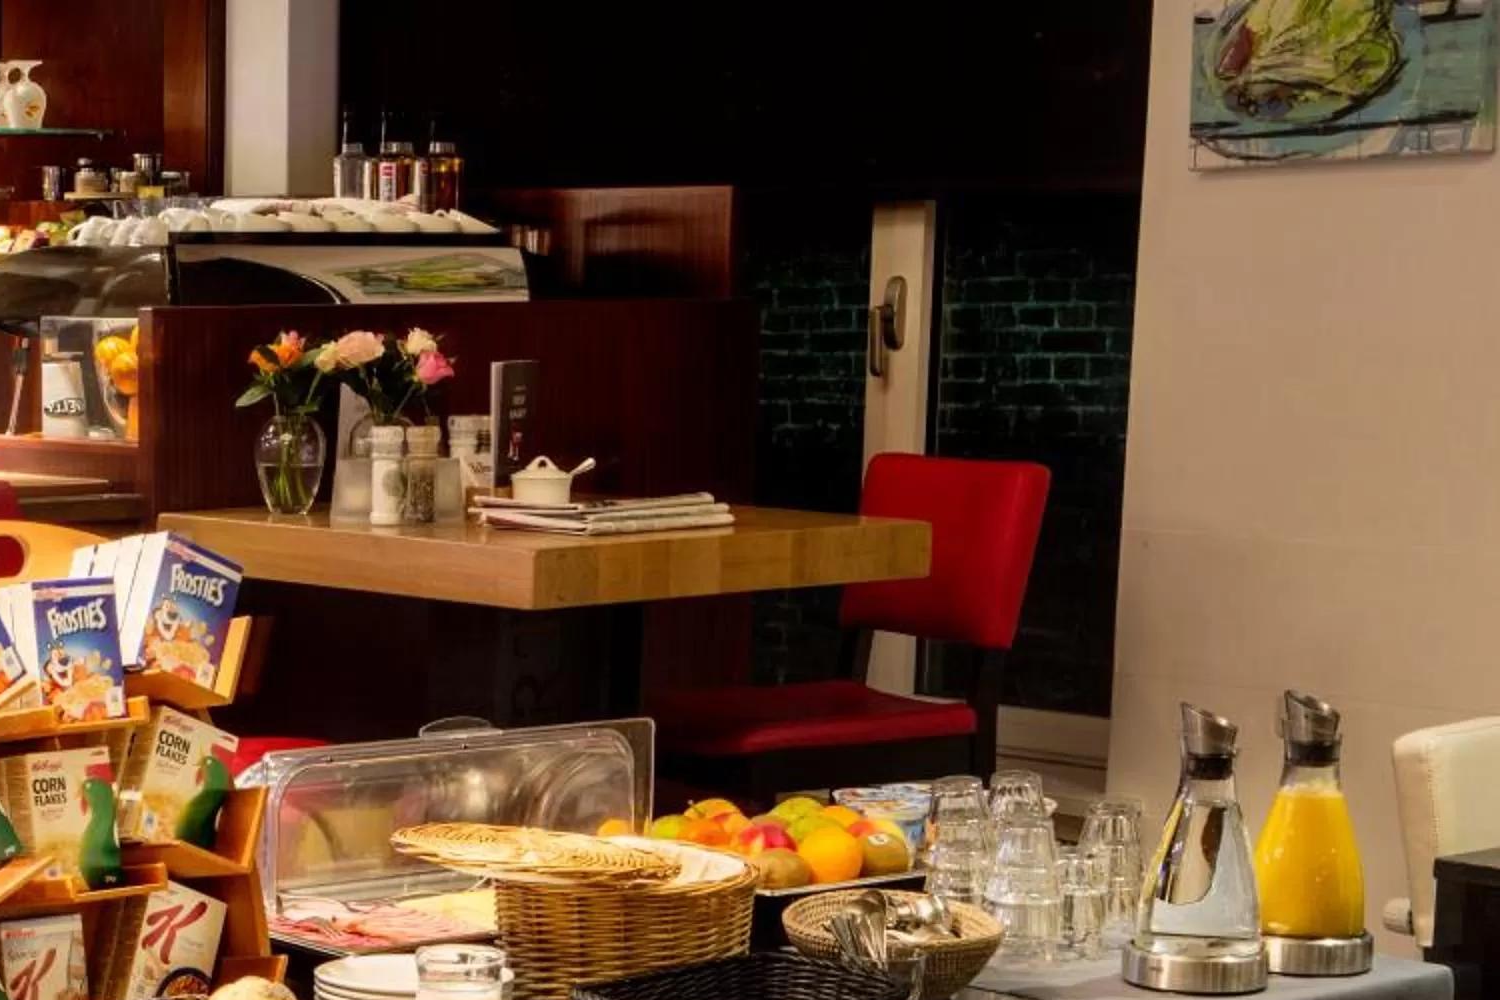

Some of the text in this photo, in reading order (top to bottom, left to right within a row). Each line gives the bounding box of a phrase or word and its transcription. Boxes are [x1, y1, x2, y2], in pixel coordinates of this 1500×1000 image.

[170, 563, 228, 606] FROSTIES
[47, 597, 107, 639] FROSTIES
[155, 743, 188, 766] FLAKES
[158, 729, 191, 755] CORN
[32, 776, 67, 794] CORN
[33, 793, 67, 807] FLAKES
[141, 901, 208, 965] K
